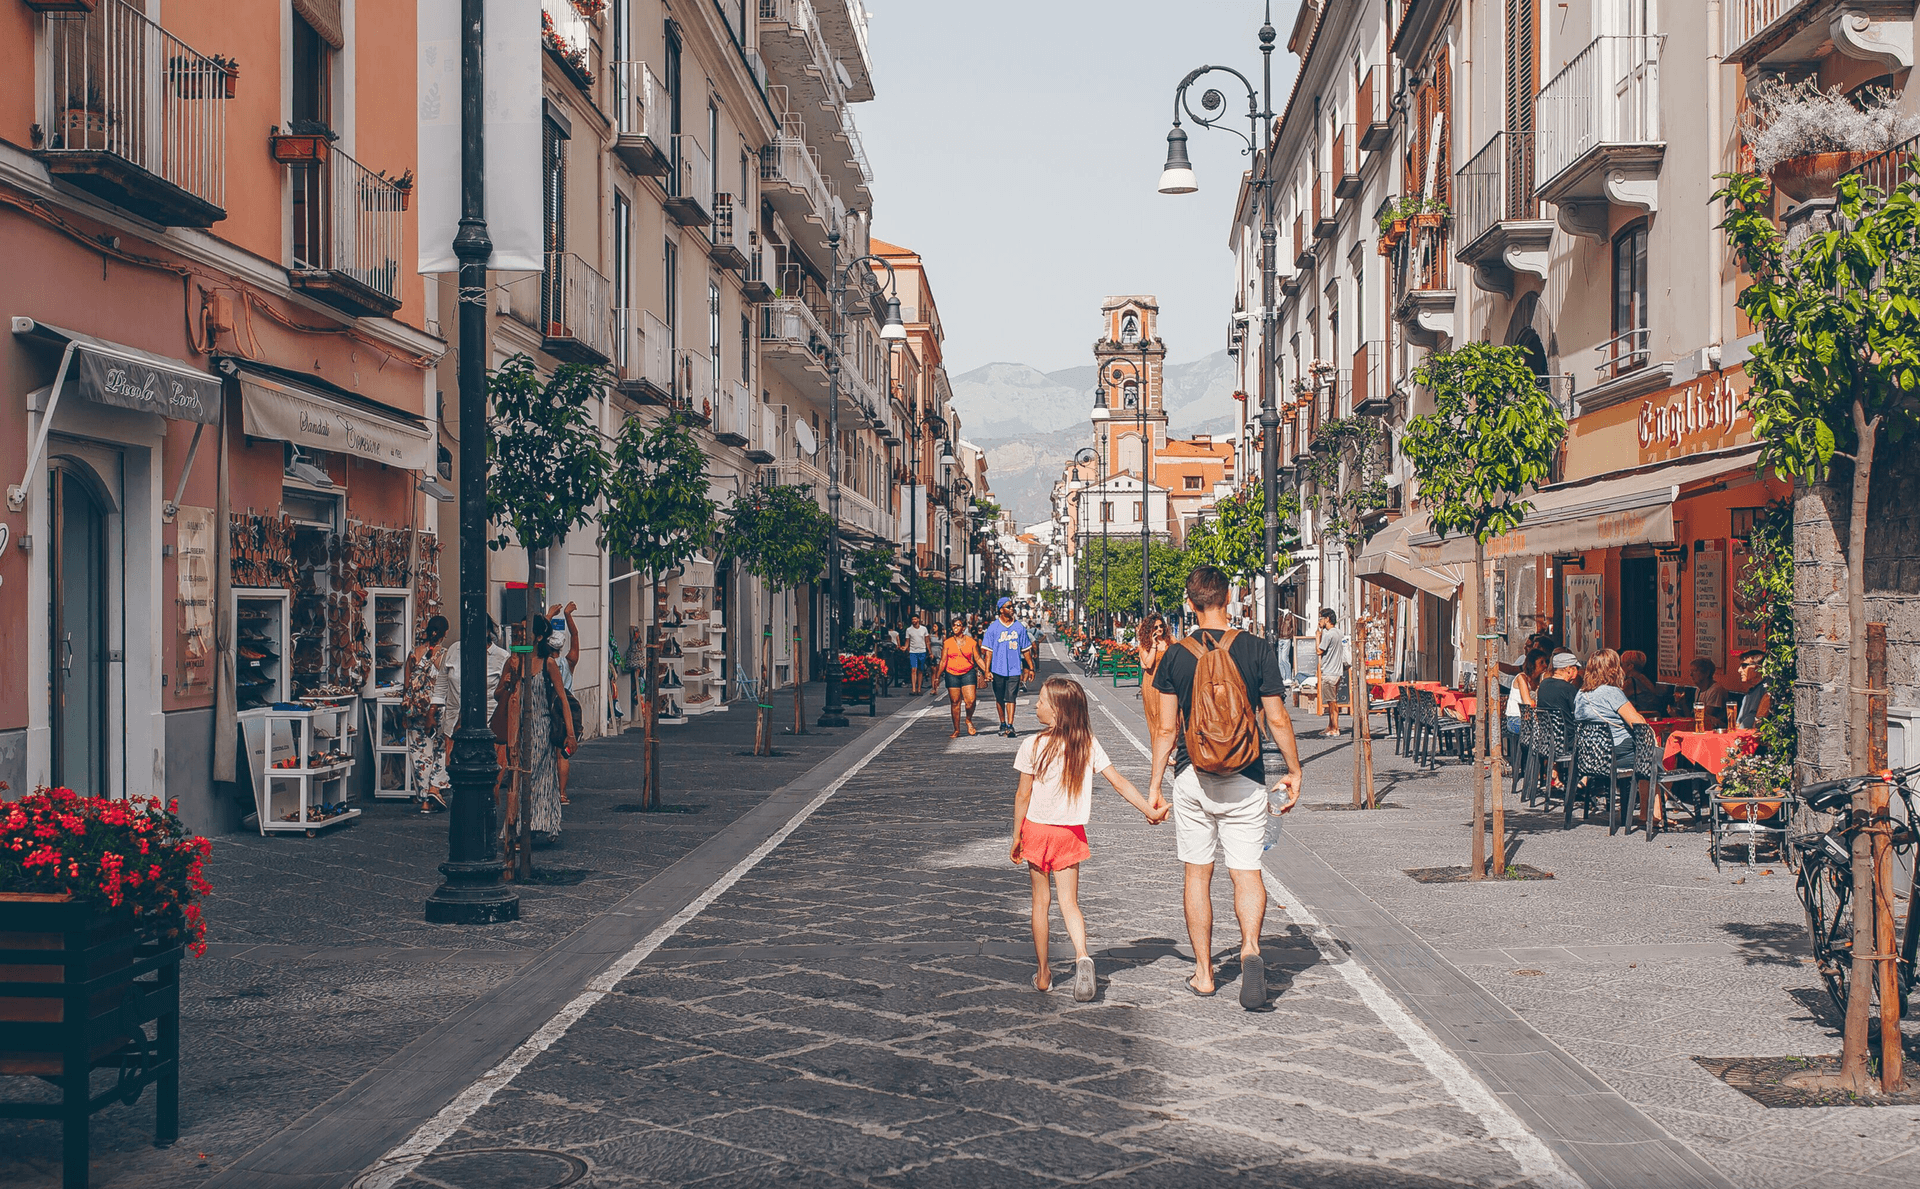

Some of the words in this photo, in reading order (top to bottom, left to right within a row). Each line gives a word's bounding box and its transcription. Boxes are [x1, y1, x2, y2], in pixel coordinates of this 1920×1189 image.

[105, 368, 155, 401] Piccolo
[170, 381, 203, 416] Lord
[1638, 375, 1736, 449] English
[300, 410, 330, 437] Sandali
